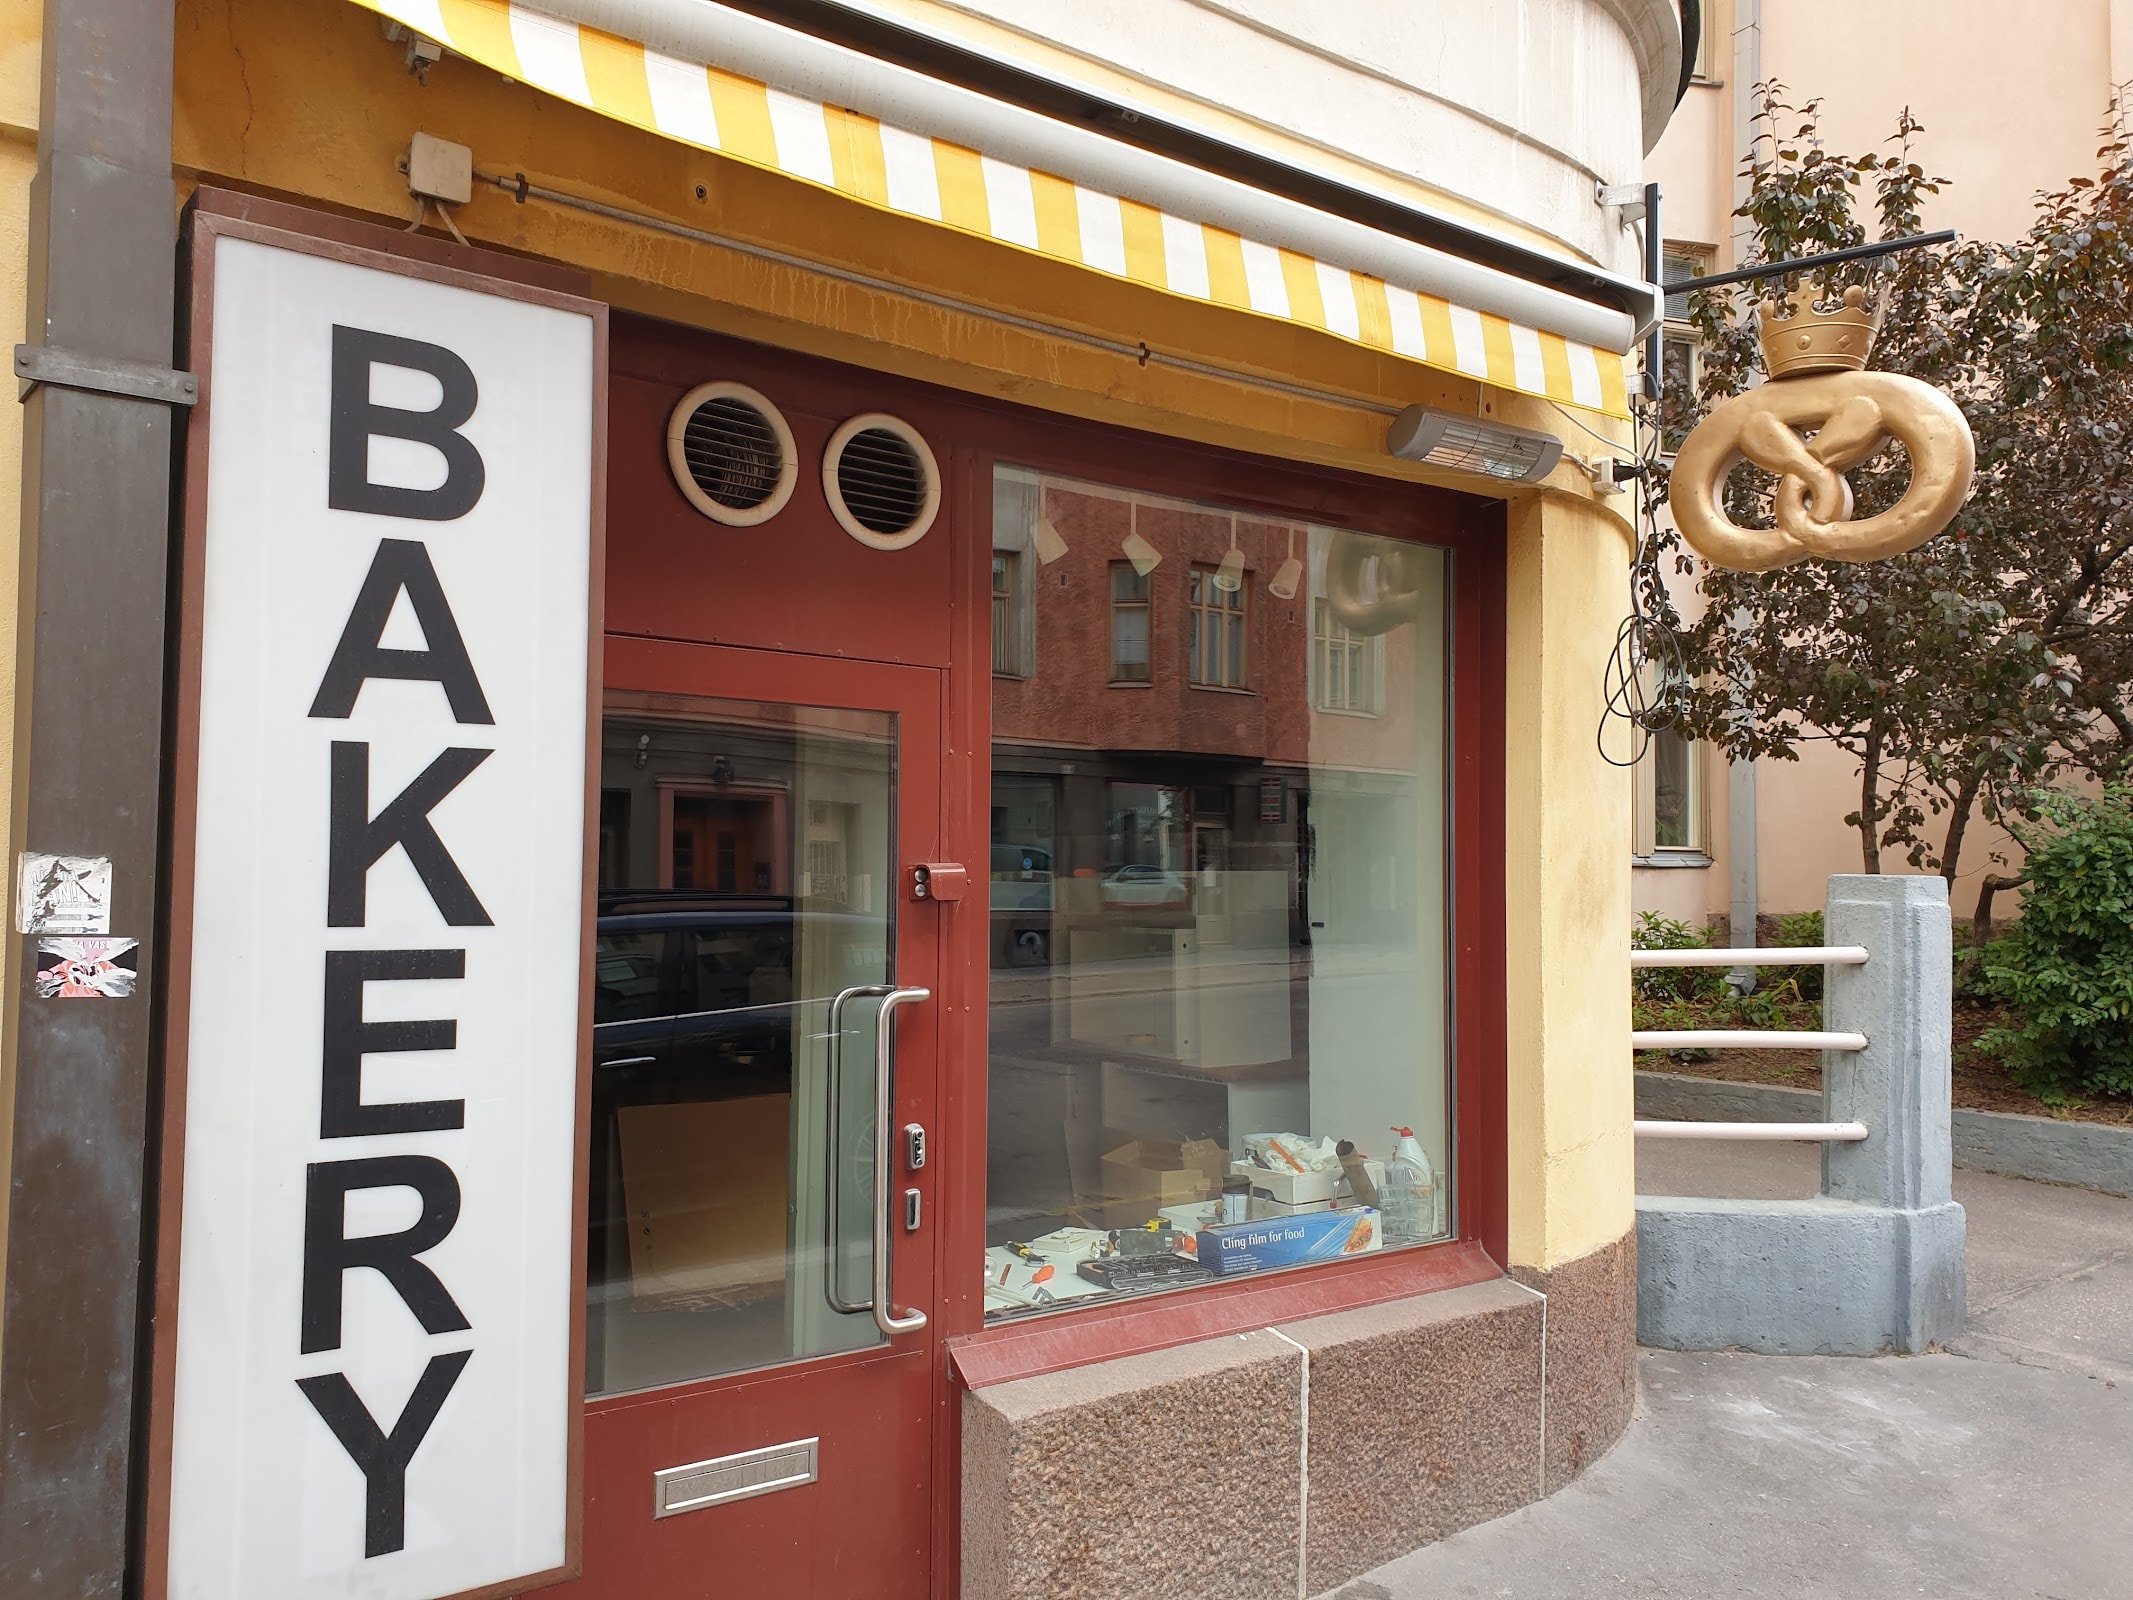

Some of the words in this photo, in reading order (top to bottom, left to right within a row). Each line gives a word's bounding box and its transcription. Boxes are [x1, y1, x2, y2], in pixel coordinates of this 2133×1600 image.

[294, 323, 496, 1560] BAKERY
[1221, 1237, 1246, 1250] Cling
[1248, 1233, 1267, 1246] film
[1269, 1231, 1282, 1243] for
[1284, 1226, 1305, 1240] food
